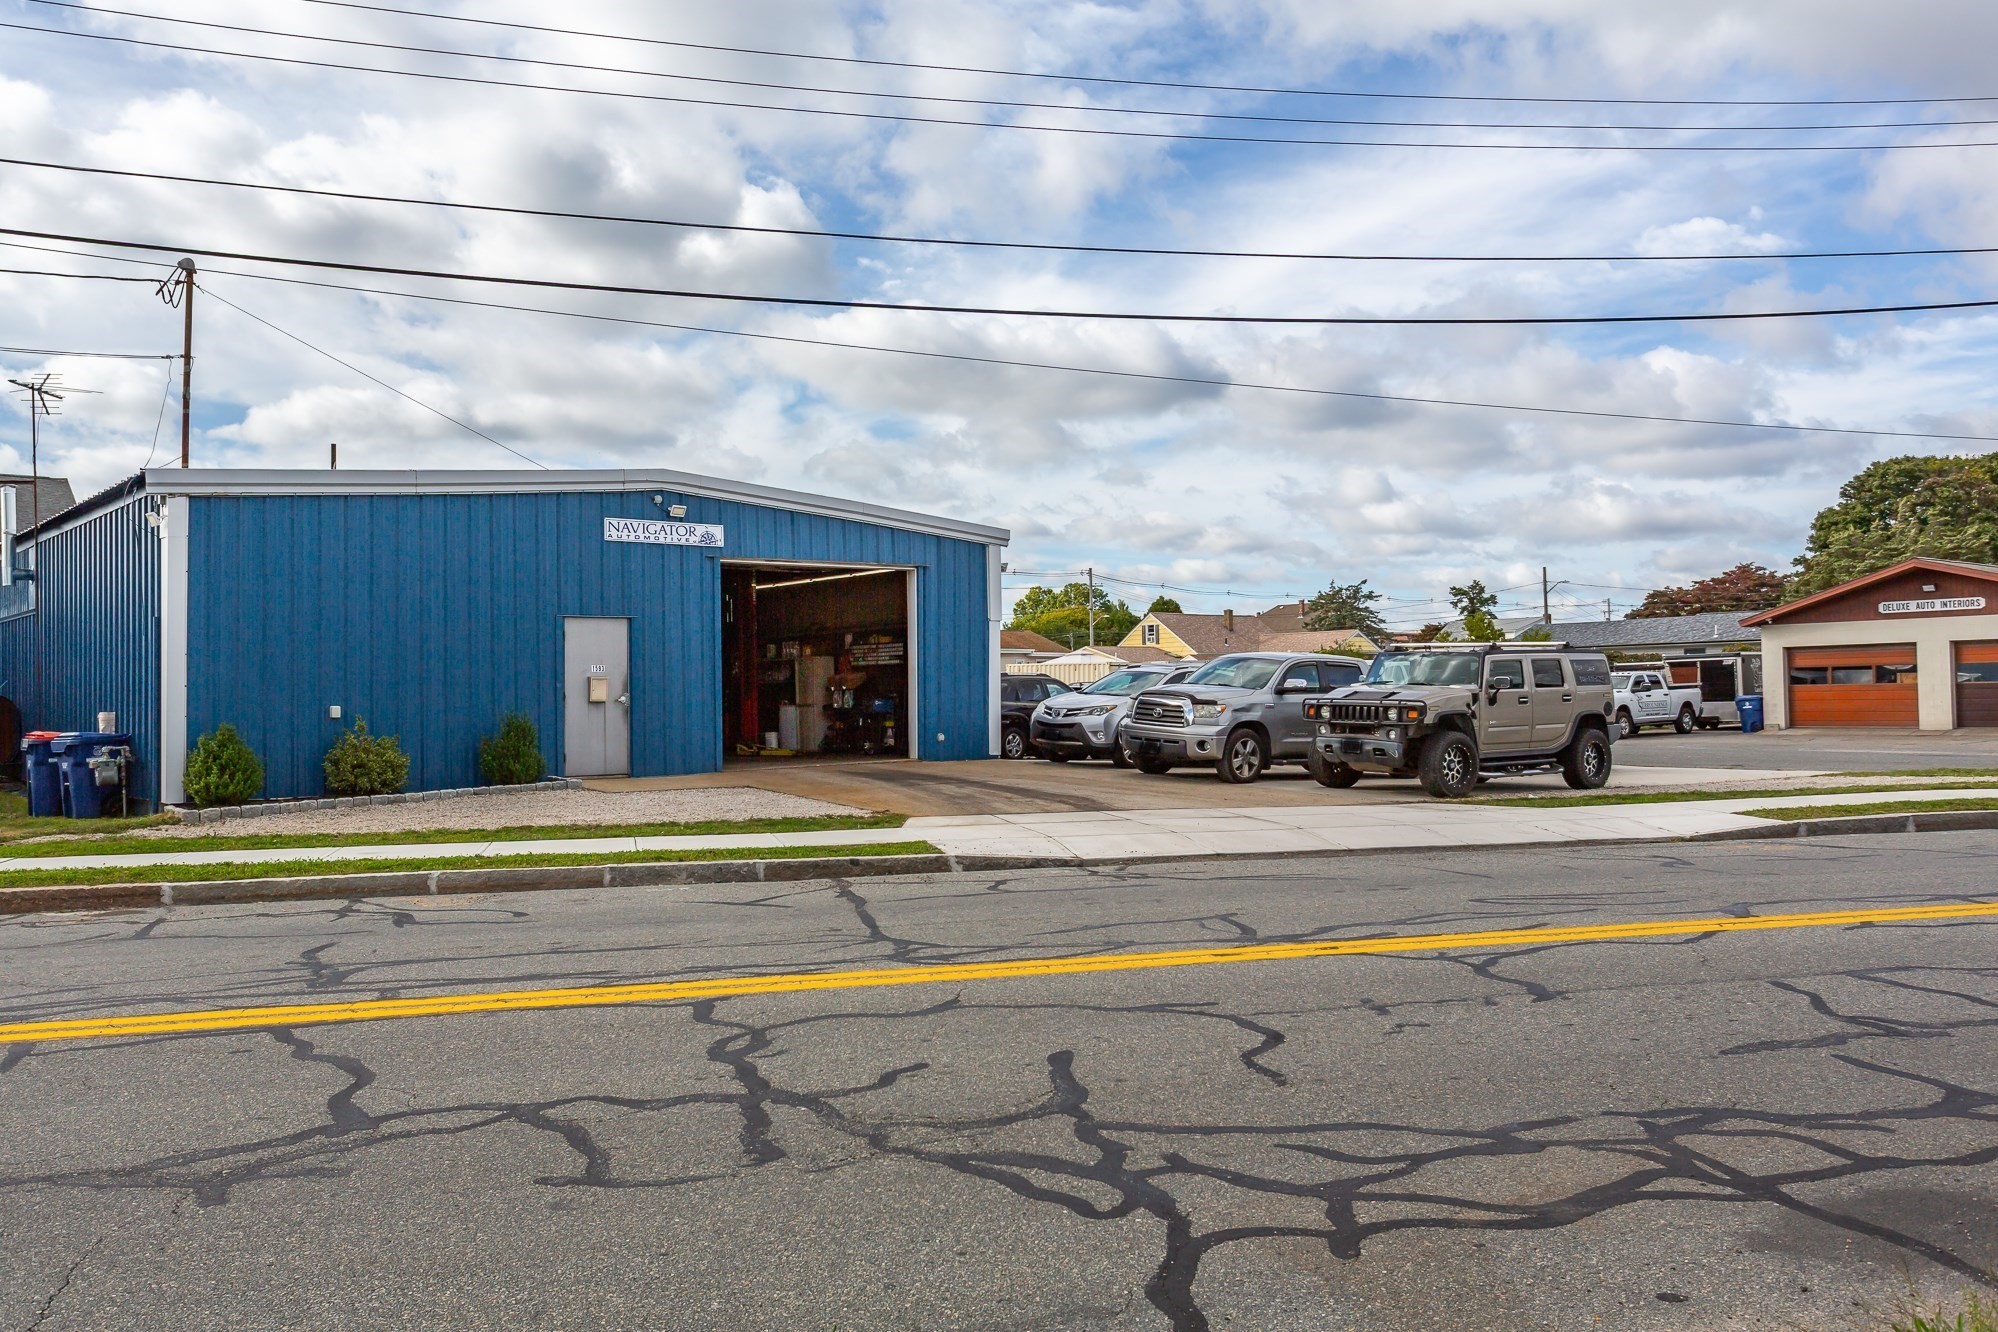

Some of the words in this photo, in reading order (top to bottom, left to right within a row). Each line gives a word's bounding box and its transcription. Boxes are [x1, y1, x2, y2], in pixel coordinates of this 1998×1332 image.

[608, 521, 698, 538] NAVIGATOR
[608, 533, 690, 542] AUTOMOTIVE
[1882, 602, 1910, 612] DELUXE
[1915, 601, 1935, 610] AUTO
[1940, 598, 1981, 609] INTERIORS
